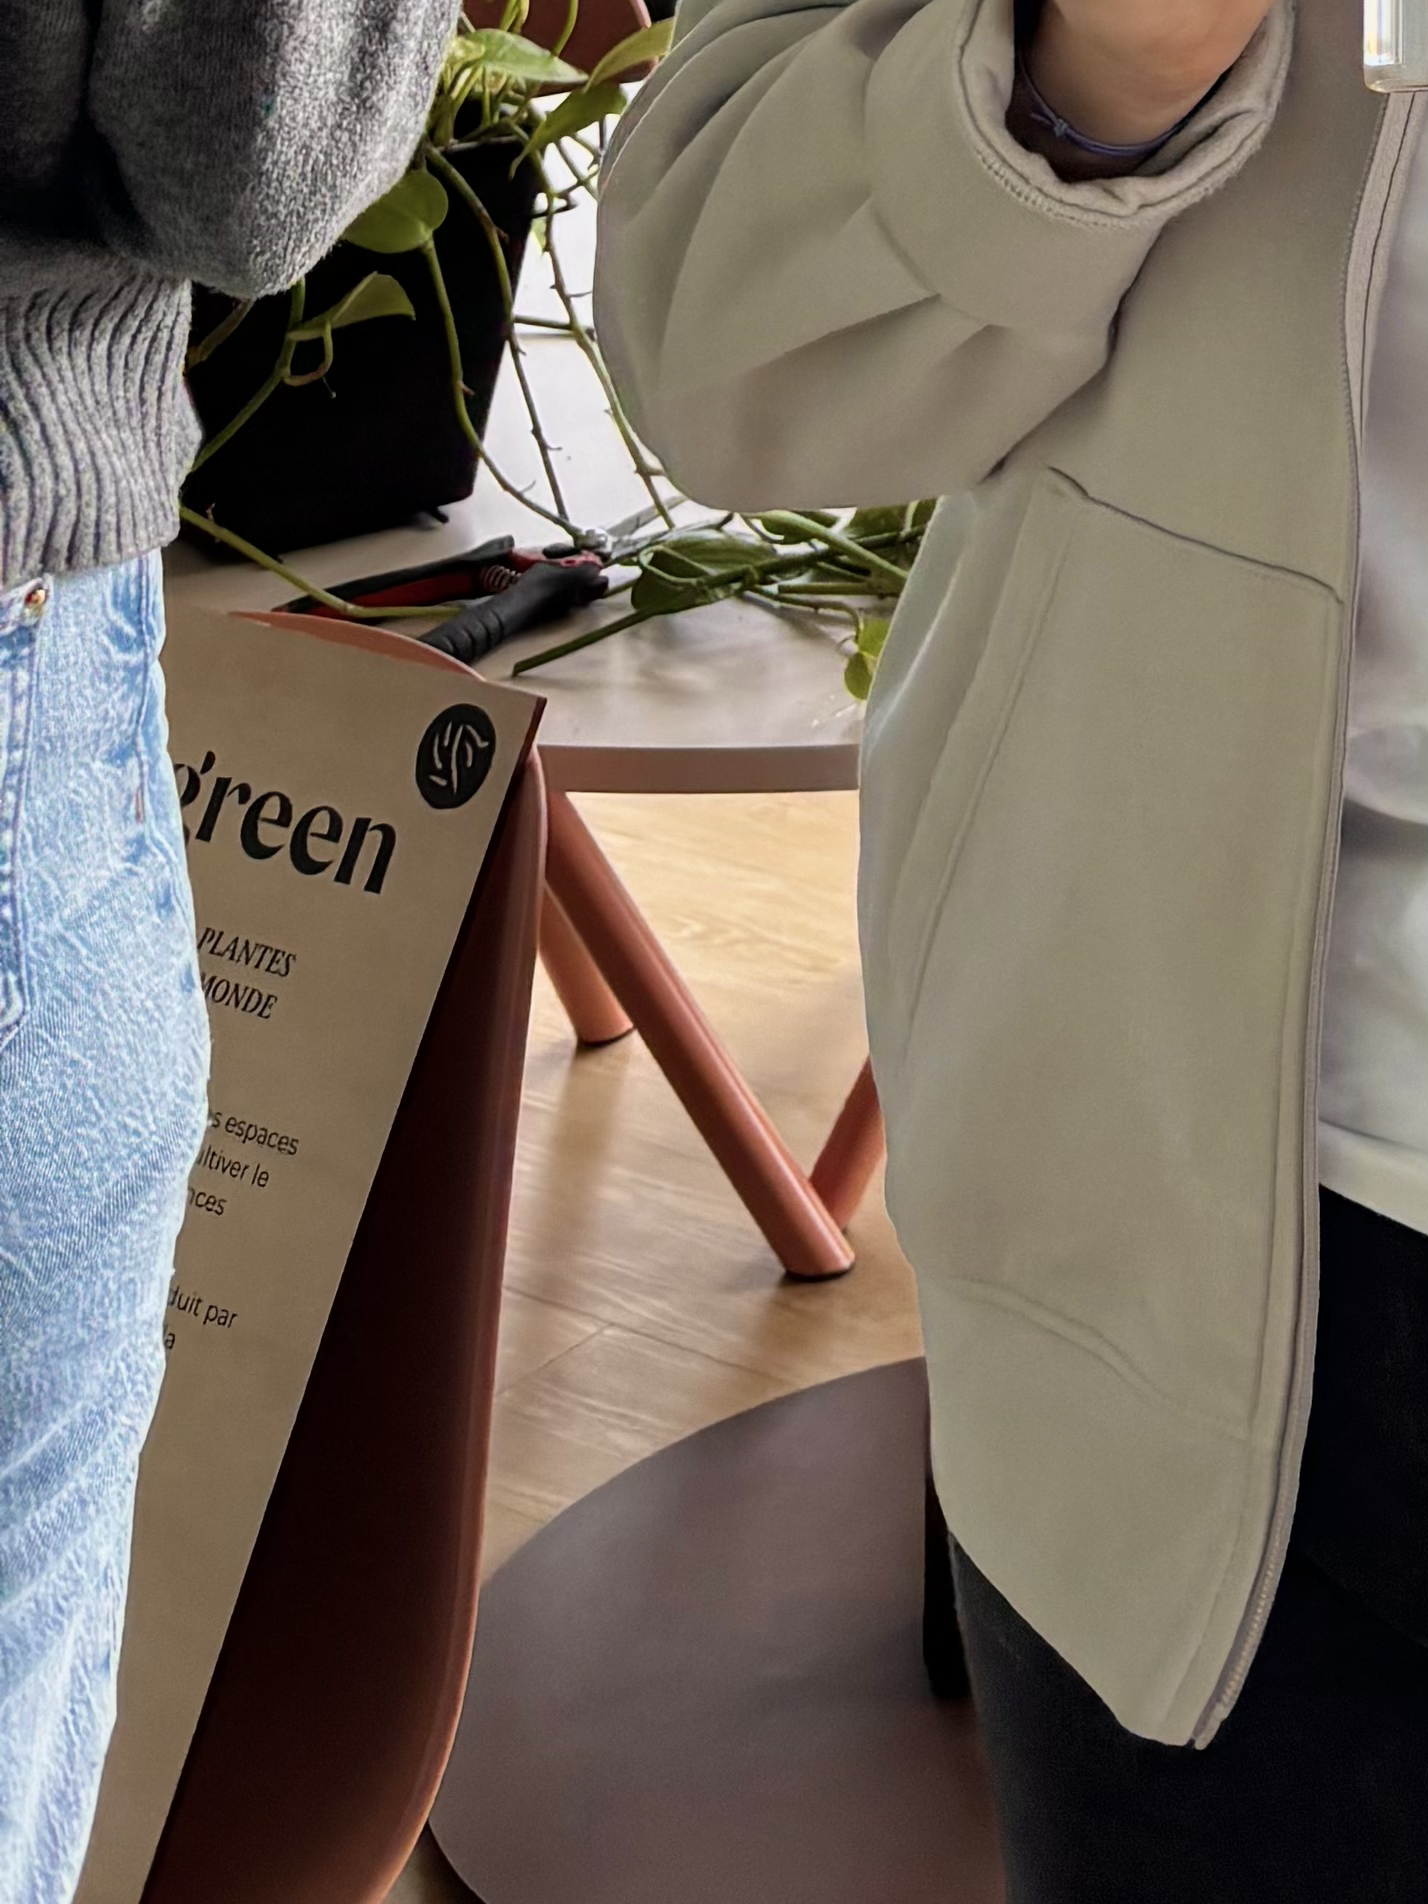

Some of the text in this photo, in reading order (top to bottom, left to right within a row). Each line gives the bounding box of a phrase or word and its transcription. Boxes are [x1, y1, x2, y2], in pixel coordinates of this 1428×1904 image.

[197, 926, 297, 978] PLANTES
[225, 1115, 299, 1156] espaces
[252, 1162, 270, 1188] le
[203, 1303, 238, 1329] par
